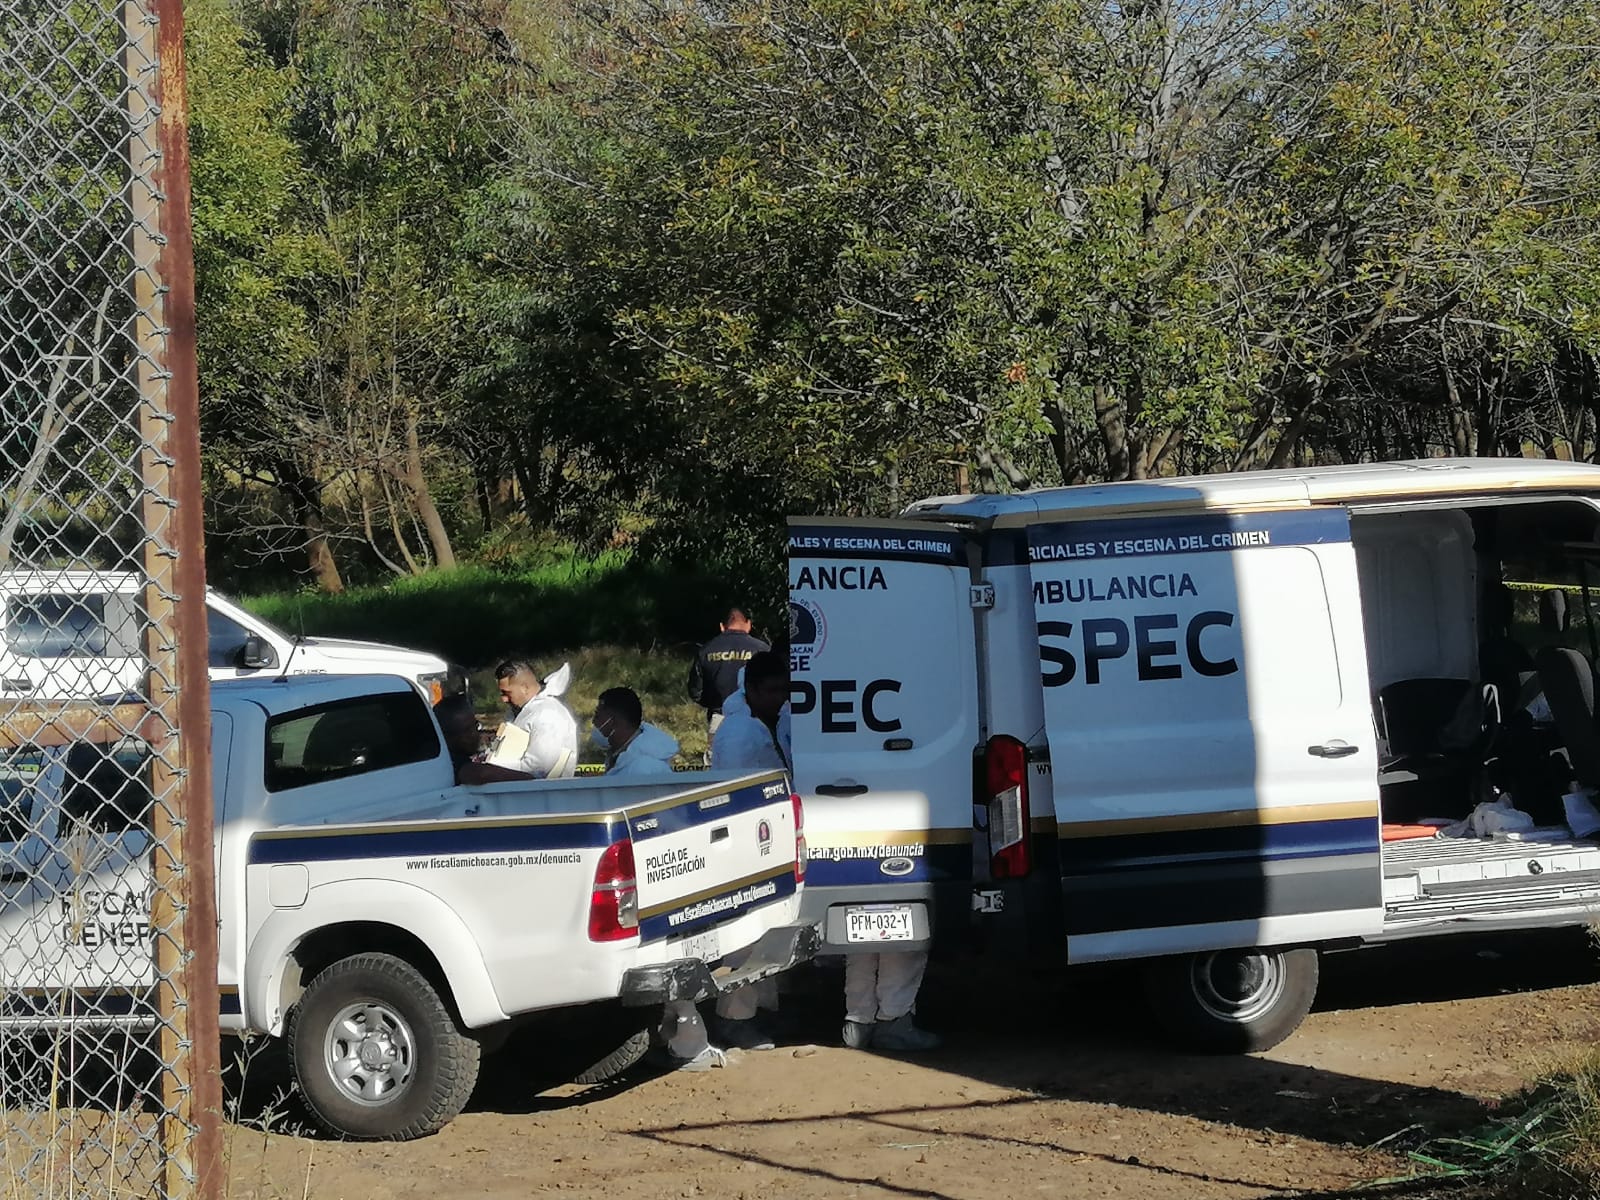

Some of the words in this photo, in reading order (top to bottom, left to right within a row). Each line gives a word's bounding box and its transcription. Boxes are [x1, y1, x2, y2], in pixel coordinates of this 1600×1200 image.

[822, 537, 831, 549] Y
[833, 538, 881, 550] ESCENA
[883, 539, 906, 550] DEL
[907, 540, 952, 553] CRIMEN
[1099, 542, 1111, 555] Y
[1114, 537, 1176, 554] ESCENA
[1179, 535, 1209, 550] DEL
[1211, 530, 1270, 547] CRIMEN
[1037, 611, 1239, 688] SPEC
[790, 679, 903, 733] PEC
[406, 852, 582, 870] wwwfiscaliamichoacan.gob.mx/denuncia
[678, 847, 689, 861] DE
